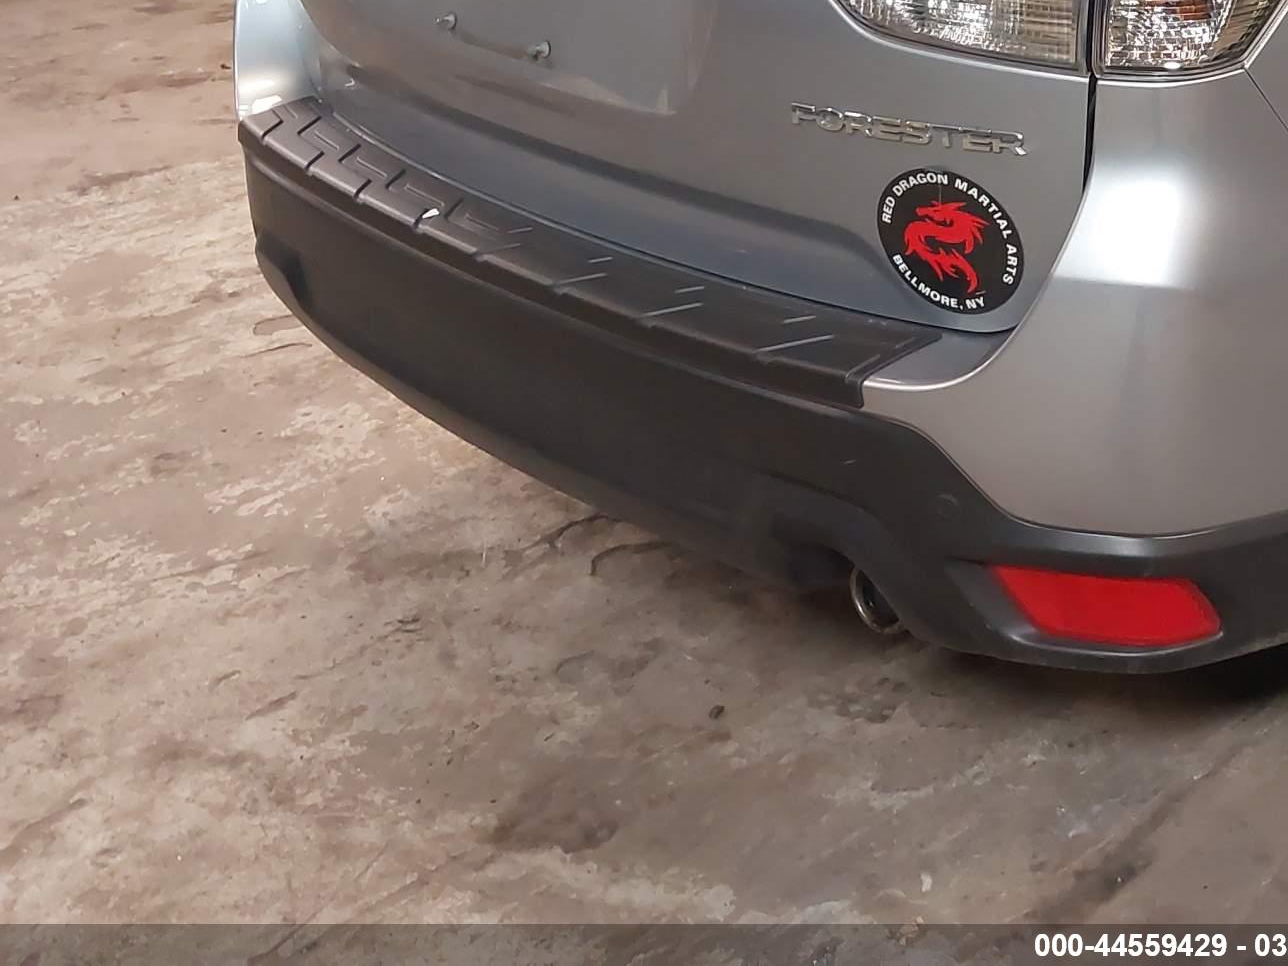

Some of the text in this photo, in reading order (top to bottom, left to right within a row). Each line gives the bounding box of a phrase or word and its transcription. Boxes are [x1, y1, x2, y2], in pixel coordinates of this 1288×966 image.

[791, 102, 1027, 156] FORESTER
[882, 172, 1018, 285] RED DRAGON MARTIAL ARTS
[892, 253, 986, 310] BELLMORE, NY
